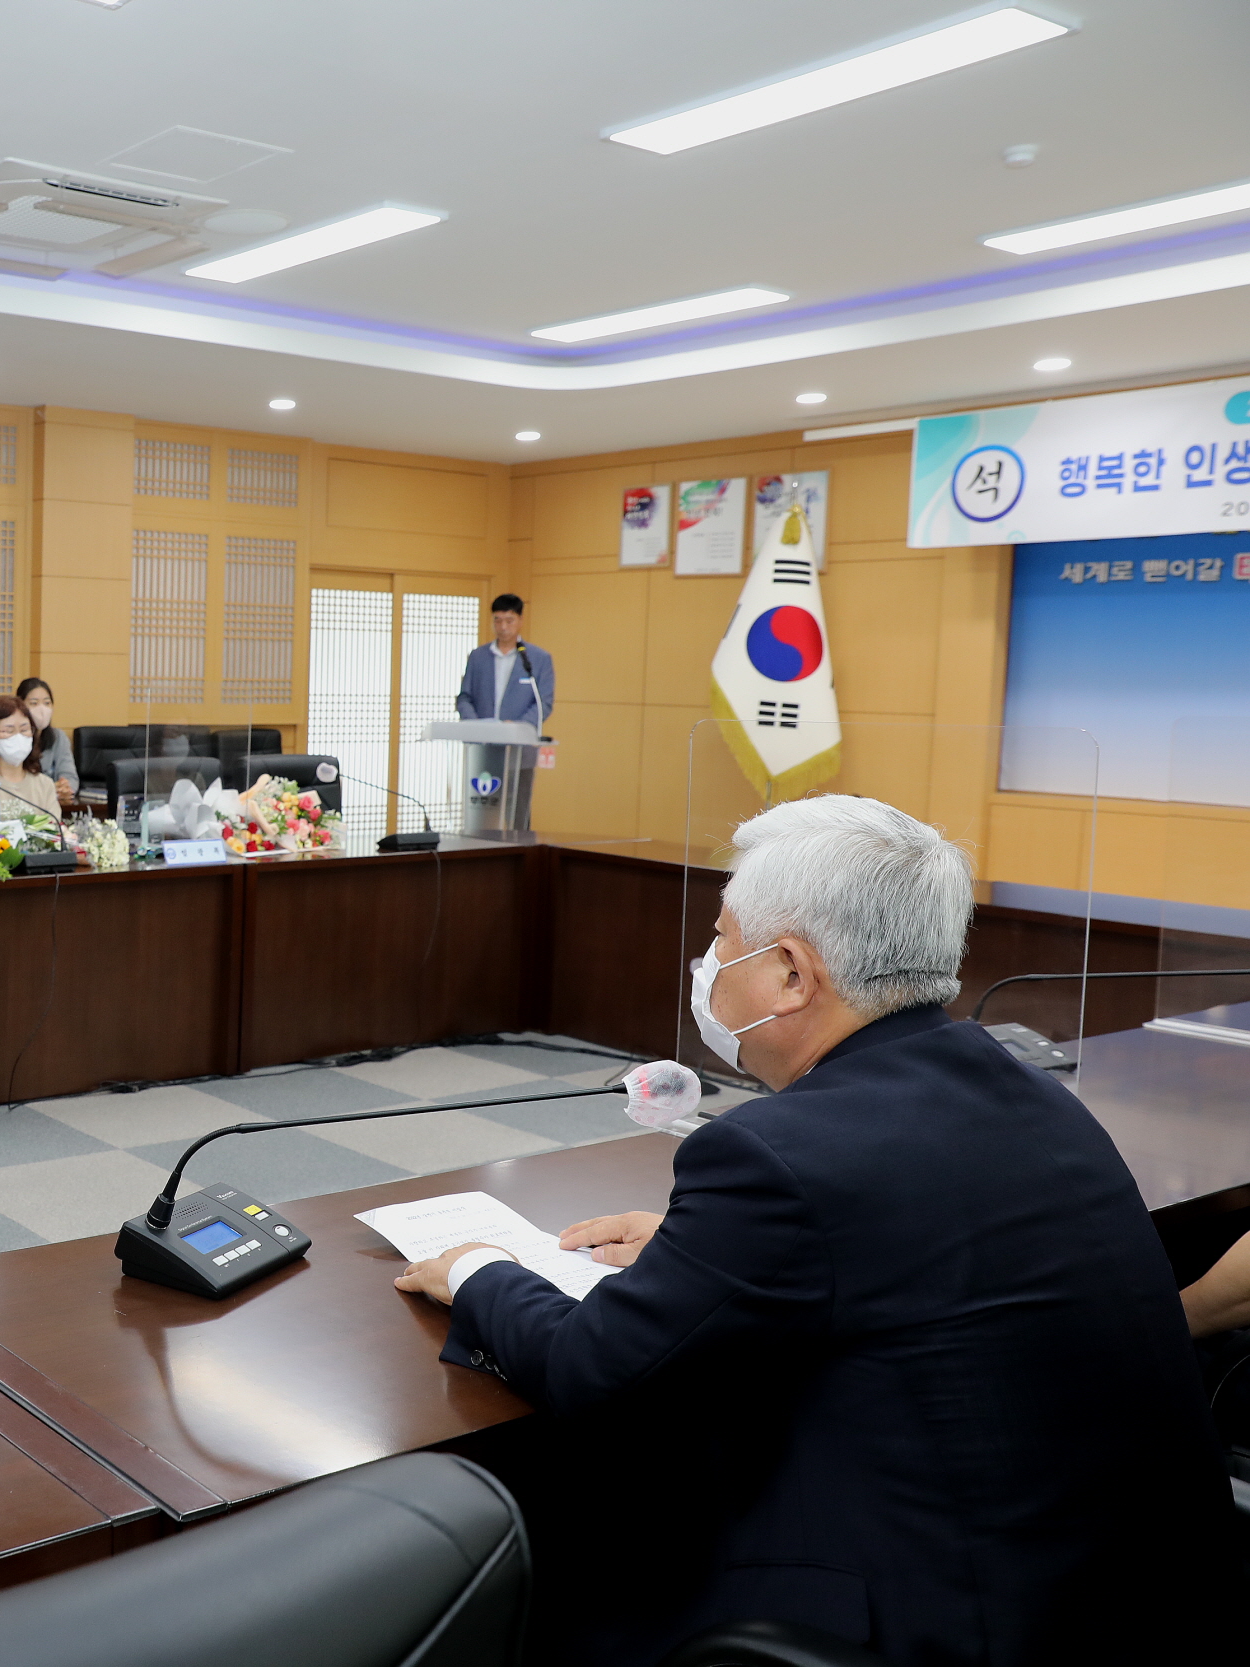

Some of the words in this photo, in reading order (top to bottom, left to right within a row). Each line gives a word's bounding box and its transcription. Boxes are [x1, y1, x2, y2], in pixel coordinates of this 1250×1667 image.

[966, 461, 1003, 504] 석
[1059, 449, 1167, 498] 행복한
[1059, 560, 1134, 584] 세계로
[1142, 557, 1224, 583] 뻗어갈
